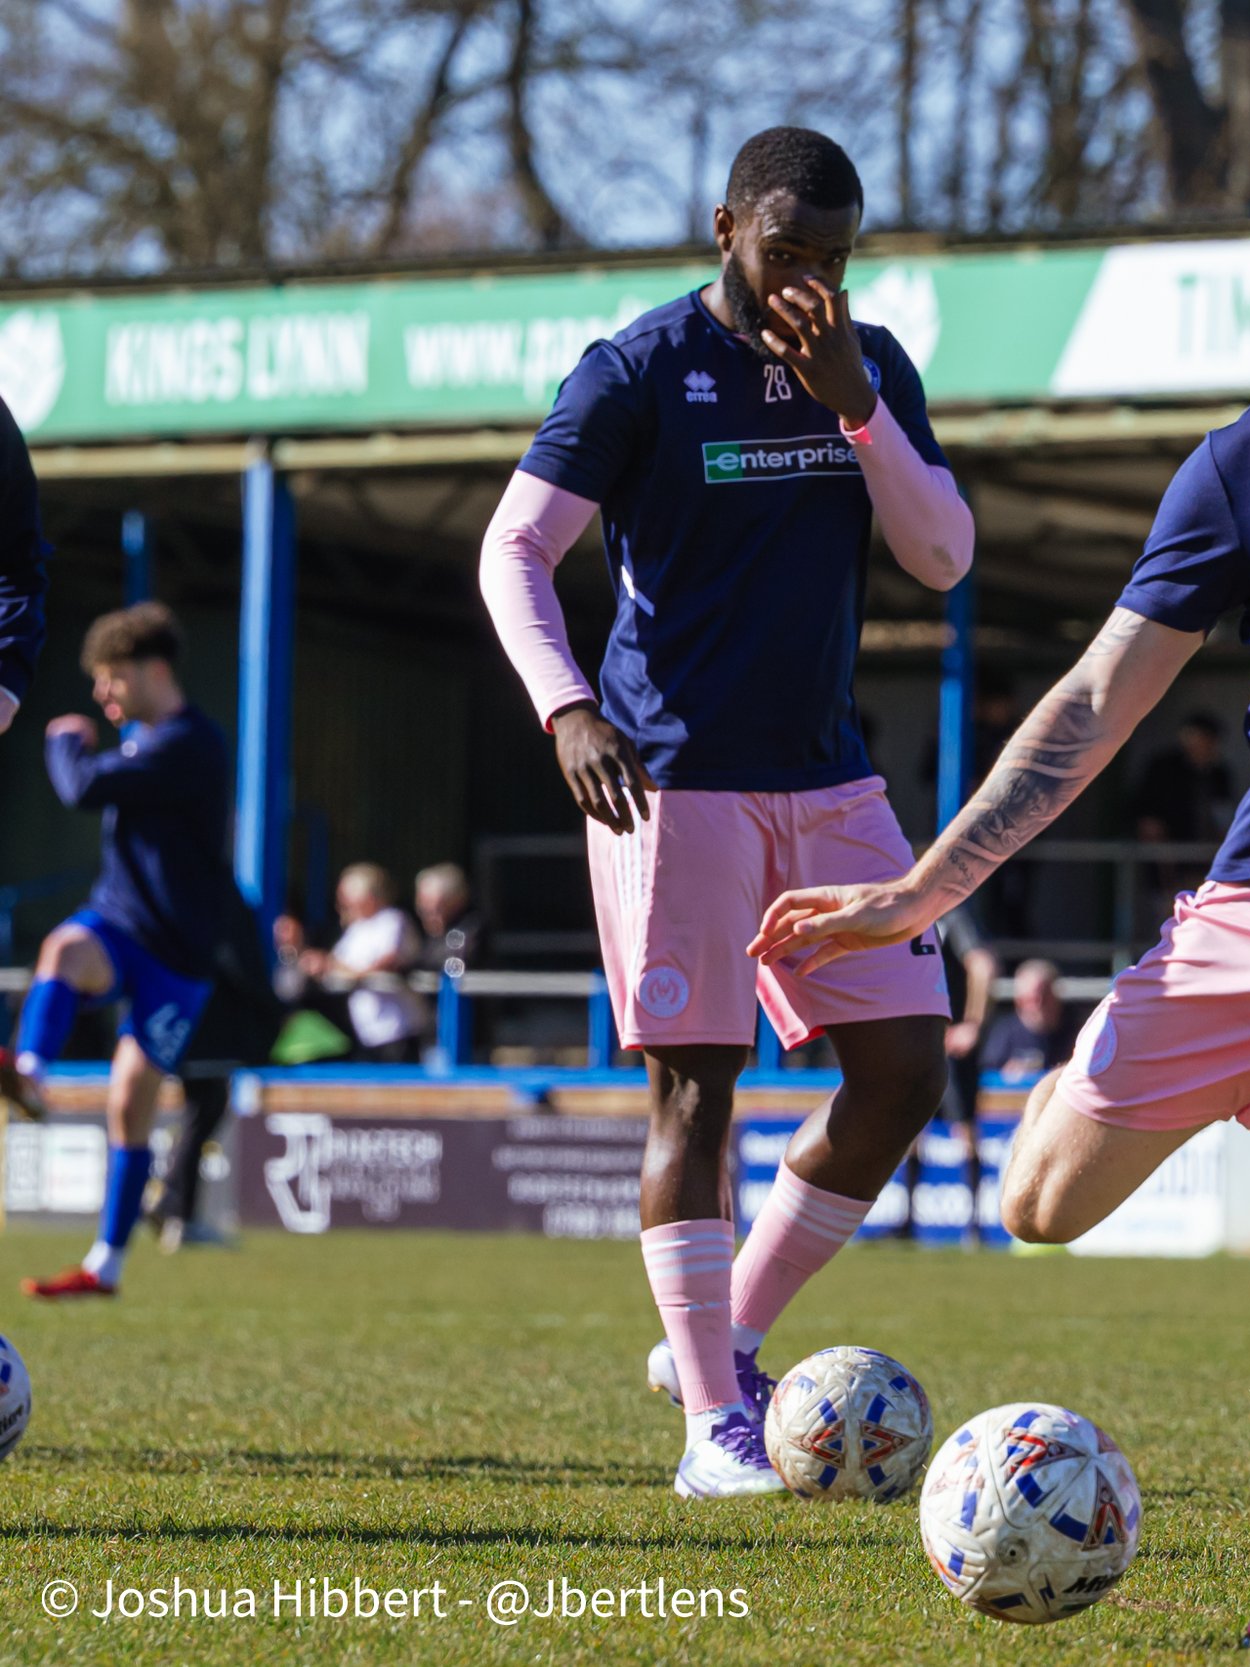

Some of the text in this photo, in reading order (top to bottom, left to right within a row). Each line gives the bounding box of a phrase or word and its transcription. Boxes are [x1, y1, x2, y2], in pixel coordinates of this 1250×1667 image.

[104, 311, 370, 406] KINGS LYNN
[764, 364, 792, 403] 28
[714, 442, 858, 471] enterprise
